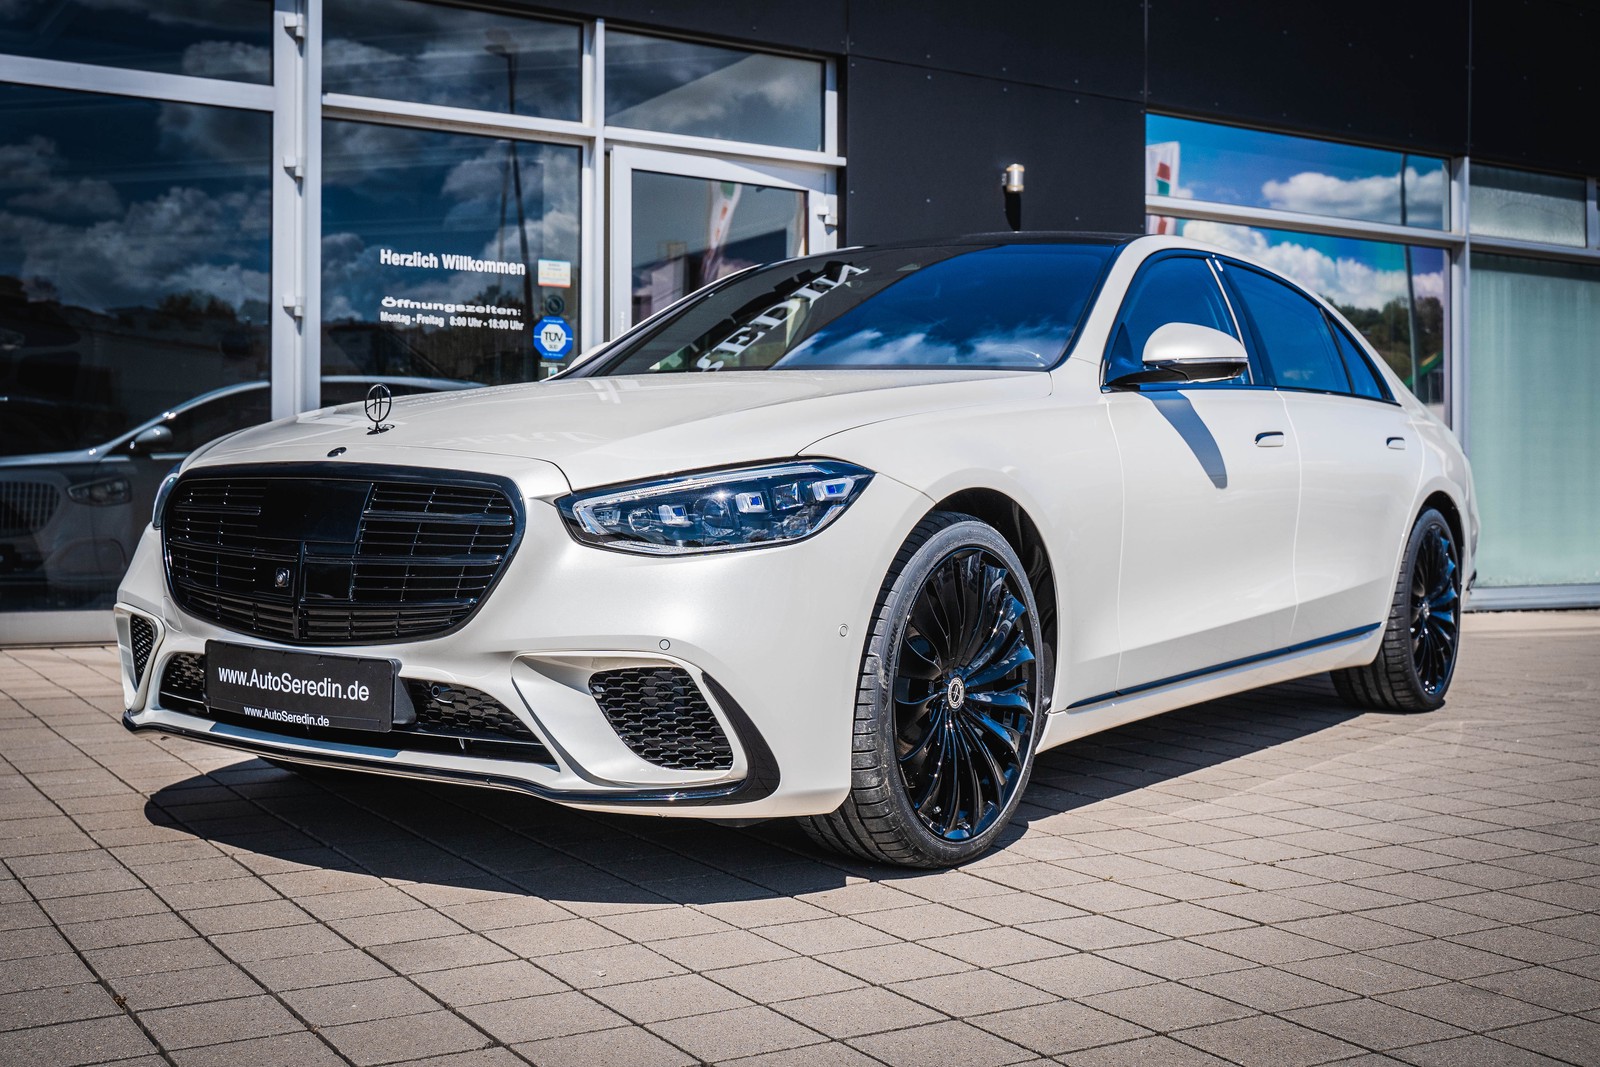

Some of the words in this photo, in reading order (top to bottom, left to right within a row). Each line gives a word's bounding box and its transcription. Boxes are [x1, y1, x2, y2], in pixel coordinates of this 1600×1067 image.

[380, 249, 439, 269] Herzlich
[441, 253, 526, 276] Willkommen
[381, 296, 522, 316] Öffnungszeiten:
[380, 311, 411, 326] Montag
[416, 313, 445, 328] Freitag
[467, 317, 483, 328] Uhr
[509, 320, 525, 331] Uhr
[218, 667, 370, 701] www.AutoSeredin.de
[243, 706, 330, 727] www.AutoSeredin.de
